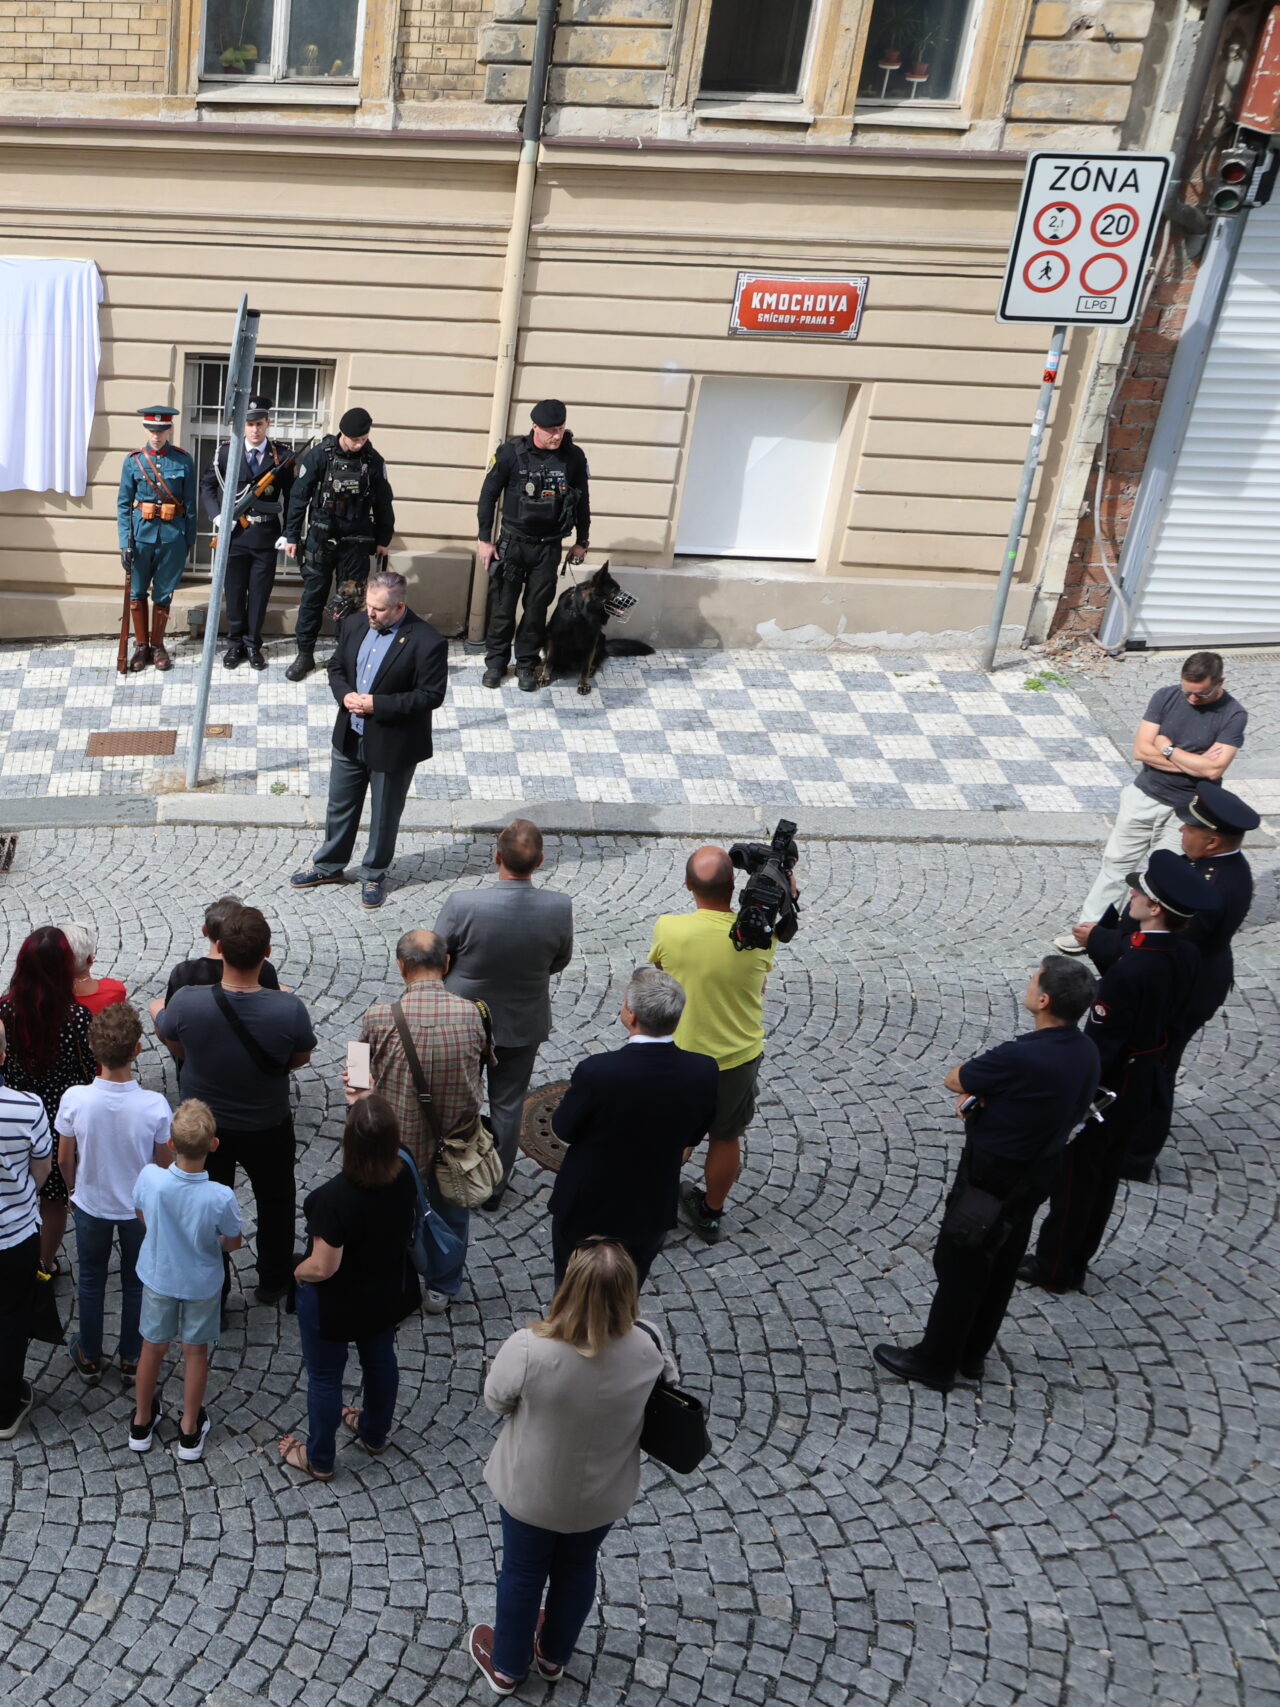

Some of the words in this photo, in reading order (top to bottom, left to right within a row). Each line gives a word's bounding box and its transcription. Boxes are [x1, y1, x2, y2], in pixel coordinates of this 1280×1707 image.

[1048, 160, 1140, 193] ZÓNA
[1099, 214, 1131, 236] 20
[751, 291, 848, 312] KMOCHOVA
[1083, 300, 1108, 310] LPG
[829, 315, 836, 325] 5
